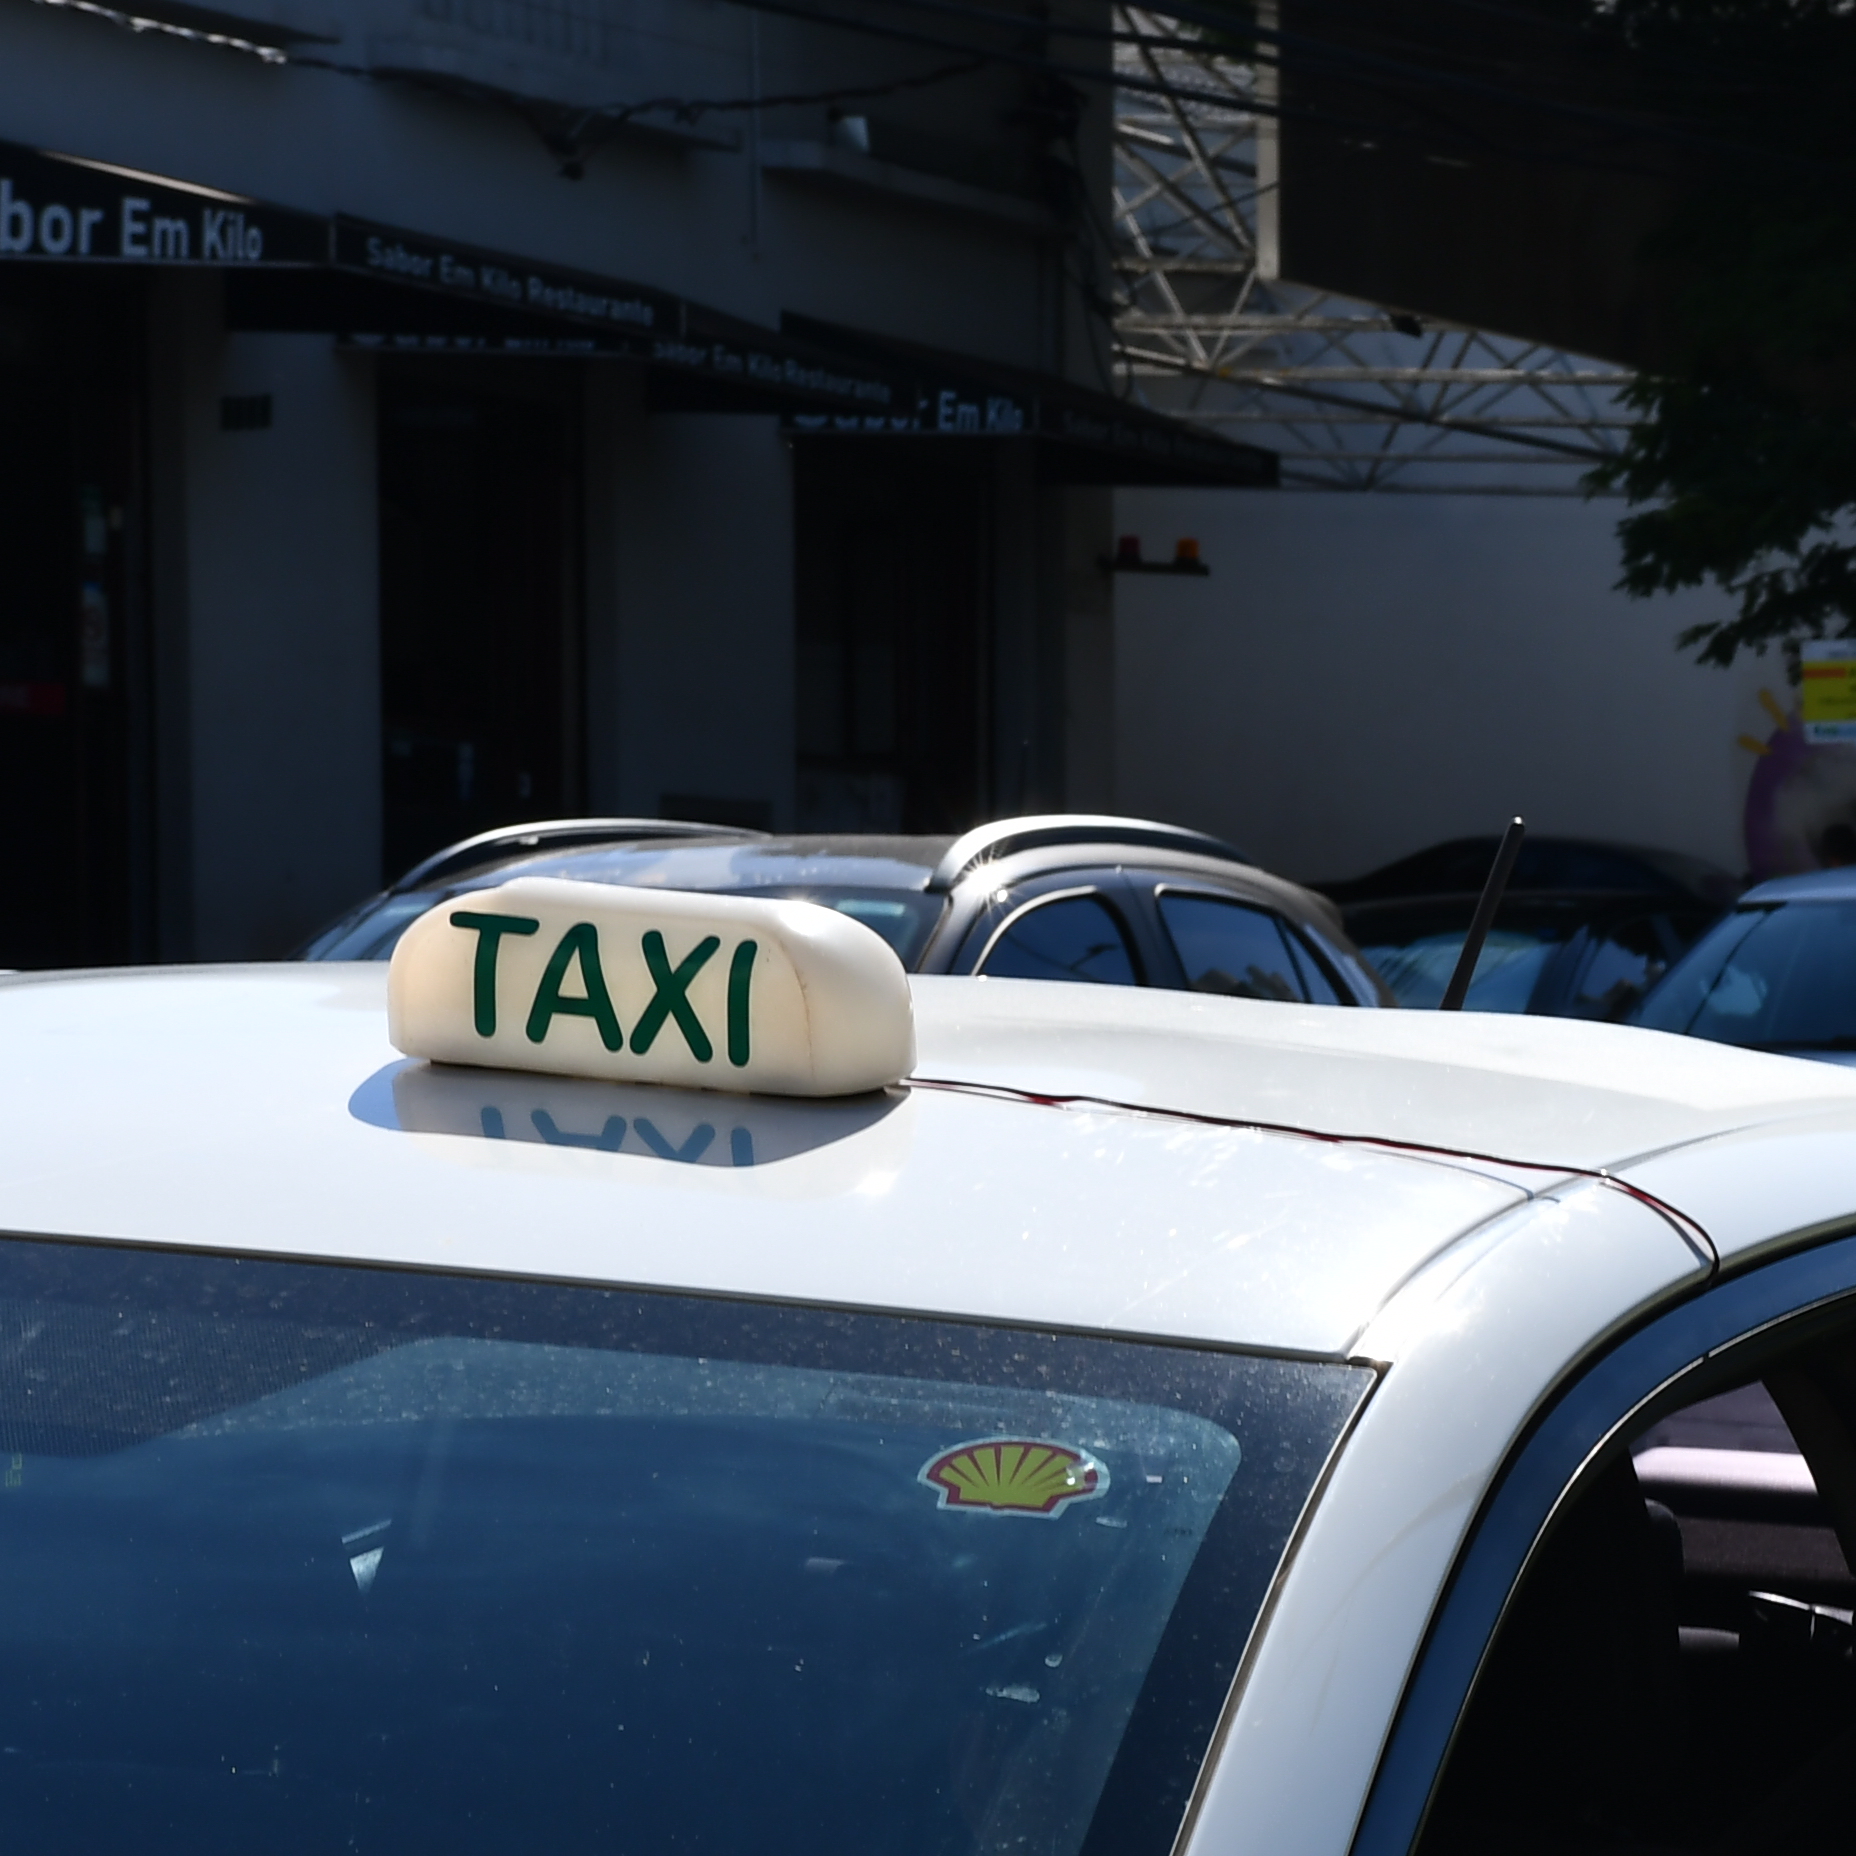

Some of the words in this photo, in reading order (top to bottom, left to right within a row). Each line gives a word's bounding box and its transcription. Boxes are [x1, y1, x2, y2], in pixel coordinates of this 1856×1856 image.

[118, 195, 191, 258] Em
[202, 206, 264, 260] Kilo
[365, 235, 432, 278] Sabor
[438, 253, 476, 287] Em
[480, 264, 523, 300] Kilo
[526, 274, 654, 327] Restaurante
[938, 389, 979, 433] Em
[449, 910, 759, 1068] TAXI
